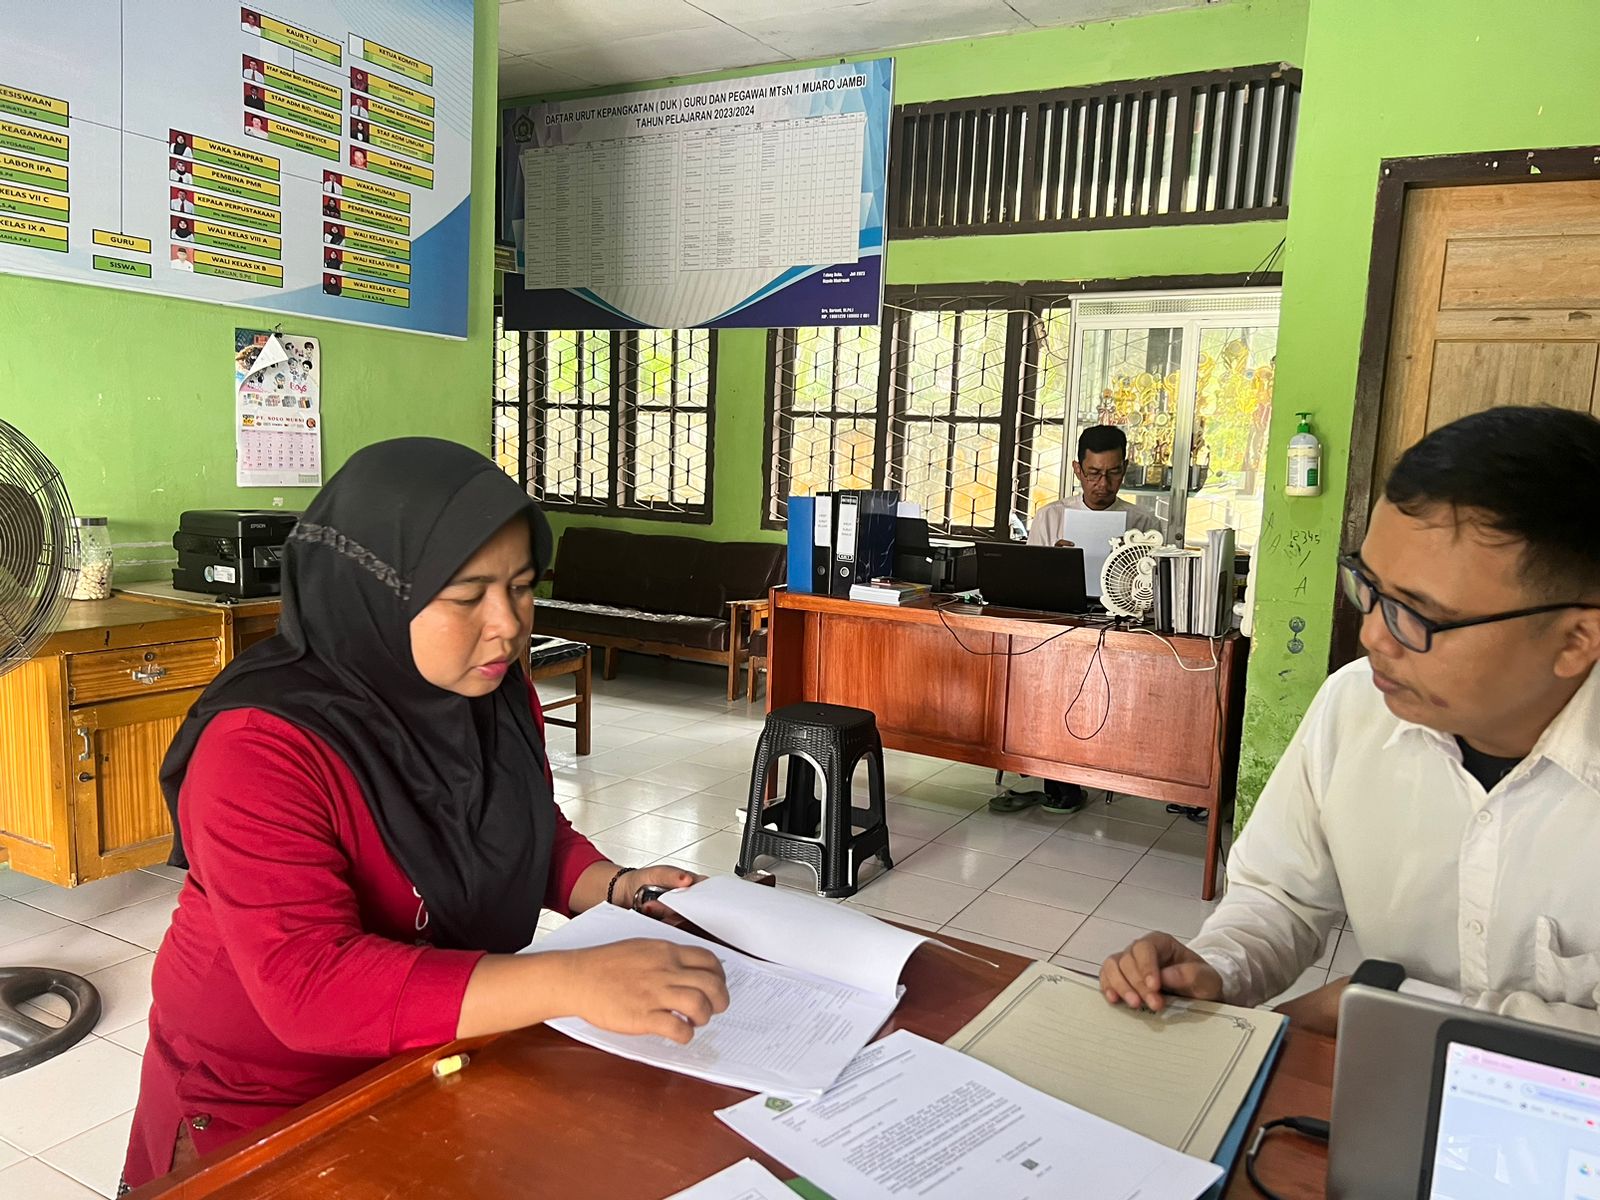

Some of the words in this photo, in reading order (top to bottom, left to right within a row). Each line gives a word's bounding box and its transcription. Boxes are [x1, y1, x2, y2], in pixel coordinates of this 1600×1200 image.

[286, 28, 304, 39] KAUR
[545, 112, 574, 125] DAFTAR
[575, 109, 596, 122] URUT
[597, 102, 654, 118] KEPANGKATAN
[660, 100, 677, 111] DUK
[684, 95, 707, 108] GURU
[709, 92, 726, 105] DAN
[728, 88, 767, 102] PEGAWAI
[769, 84, 793, 97] MTsN
[795, 84, 799, 94] 1
[802, 79, 835, 93] MUARO
[837, 75, 865, 89] JAMBI
[286, 99, 300, 108] ADM
[314, 109, 335, 119] HUMAS
[636, 116, 663, 128] TAHUN
[665, 110, 712, 125] PELAJARAN
[714, 105, 754, 119] 2023/2024
[2, 124, 62, 144] KEAGAMAAN
[276, 125, 304, 138] CLEANING
[305, 133, 326, 144] SERVICE
[209, 143, 231, 154] WAKA
[233, 150, 263, 163] SARPRAS
[4, 158, 34, 170] LABOR
[37, 165, 52, 173] IPA
[212, 171, 244, 184] PEMBINA
[246, 180, 262, 188] PMR
[0, 188, 27, 198] KELAS
[356, 182, 374, 191] WAKA
[375, 188, 396, 197] HUMAS
[197, 196, 223, 206] KEPALA
[225, 202, 275, 218] PERPUSTAKAAN
[348, 204, 374, 215] PEMBINA
[207, 226, 226, 234] WALI
[228, 231, 248, 240] KELAS
[369, 234, 385, 242] KELAS
[110, 237, 134, 245] GURU
[110, 262, 136, 271] SISWA
[232, 260, 252, 269] KELAS
[1294, 576, 1307, 598] A
